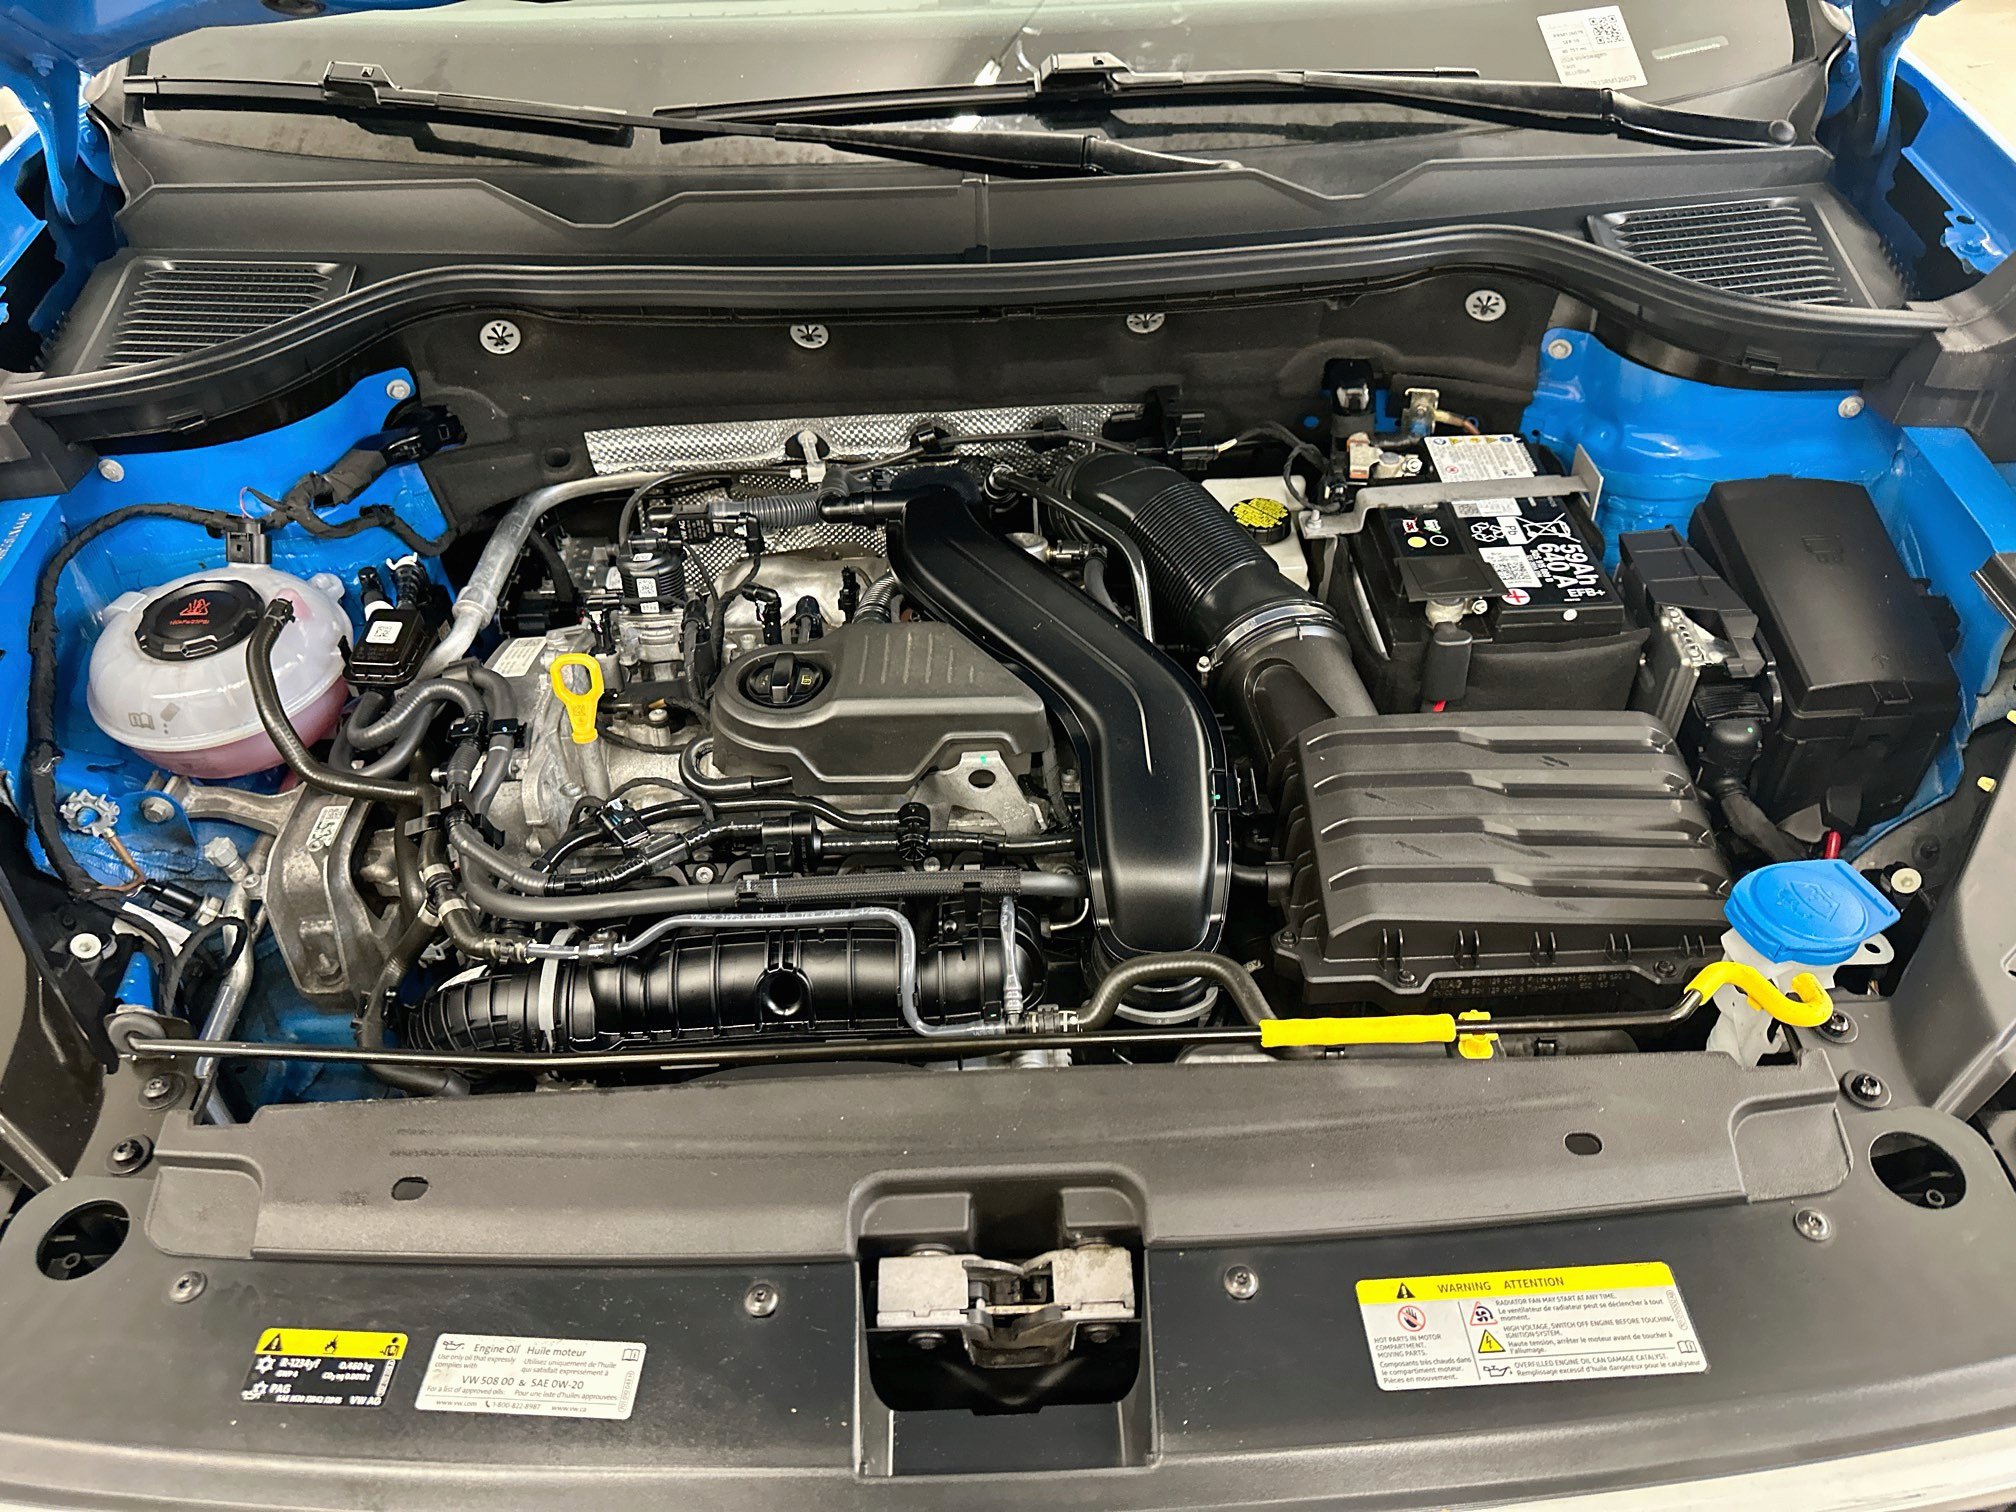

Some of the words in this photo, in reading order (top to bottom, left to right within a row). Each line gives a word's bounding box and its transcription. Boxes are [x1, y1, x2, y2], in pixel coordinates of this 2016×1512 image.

[1505, 525, 1517, 536] Pb
[1537, 543, 1571, 572] 640
[1560, 544, 1599, 585] 59Ah
[1552, 575, 1579, 589] A
[1566, 587, 1606, 598] EFB+
[1437, 1281, 1492, 1294] WARNING
[1504, 1277, 1565, 1289] ATTENTION
[1496, 1298, 1527, 1306] RADIATOR
[1542, 1296, 1556, 1304] MAY
[1507, 1306, 1541, 1314] ventilateur
[1553, 1302, 1582, 1311] radiateur
[1583, 1301, 1599, 1311] peut
[1608, 1299, 1642, 1308] déclencher
[1551, 1322, 1576, 1330] SWITCH
[1641, 1316, 1674, 1324] TOUCHING
[1418, 1333, 1442, 1341] MOTOR
[1557, 1337, 1579, 1345] arrêter
[474, 1344, 505, 1355] Engine
[506, 1344, 521, 1354] Oil
[527, 1346, 551, 1356] Huile
[553, 1348, 587, 1357] moteur
[279, 1358, 321, 1371] R-1234yf
[450, 1354, 464, 1362] only
[487, 1356, 516, 1365] expressly
[548, 1359, 588, 1368] uniquement
[1380, 1360, 1419, 1368] Composants
[1433, 1357, 1456, 1365] chauds
[1514, 1361, 1554, 1369] OVERFILLED
[1608, 1355, 1635, 1363] DAMAGE
[521, 1366, 532, 1374] qui
[559, 1368, 603, 1376] expressément
[1389, 1367, 1436, 1376] compartiment
[1516, 1369, 1558, 1377] Remplissage
[1559, 1366, 1584, 1374] excessif
[1609, 1363, 1643, 1372] dangereux
[1668, 1360, 1700, 1368] catalyseur
[462, 1375, 480, 1384] VW
[480, 1376, 499, 1385] 508
[500, 1377, 515, 1386] 00
[518, 1379, 526, 1387] &
[531, 1378, 549, 1388] SAE
[551, 1380, 584, 1389] 0W-20
[269, 1383, 292, 1394] PAG
[462, 1387, 492, 1395] approved
[515, 1389, 529, 1397] Pour
[349, 1396, 368, 1405] VW
[492, 1401, 541, 1410] 1-800-822-8987
